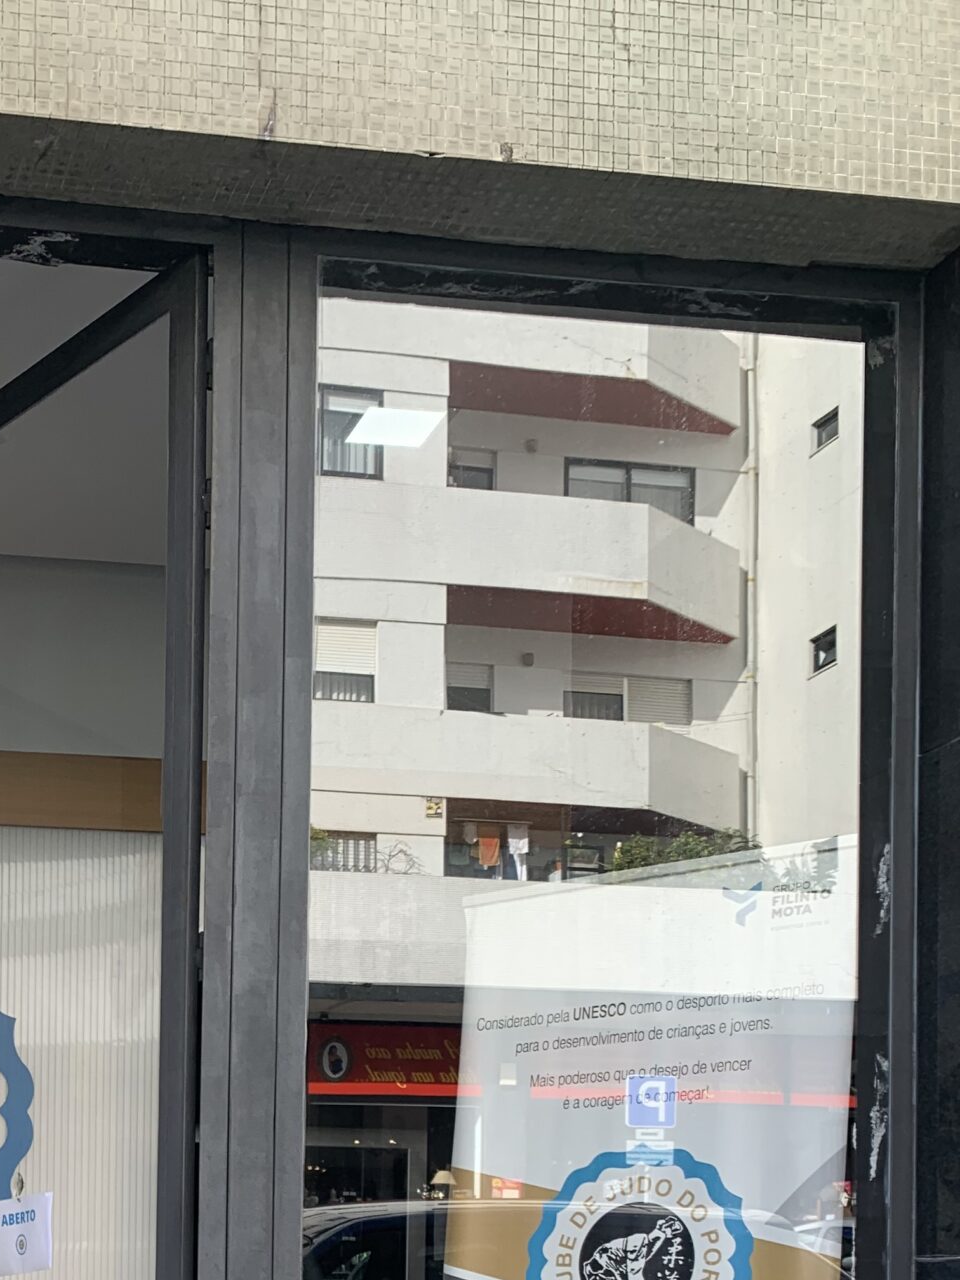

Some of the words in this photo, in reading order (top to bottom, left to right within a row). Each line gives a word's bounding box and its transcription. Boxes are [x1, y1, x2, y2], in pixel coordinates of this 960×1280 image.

[771, 889, 832, 906] FILINTO
[772, 880, 811, 892] GRUPO
[771, 904, 812, 919] MOTA
[476, 1013, 543, 1031] Considerado
[546, 1010, 569, 1027] pela
[573, 1002, 626, 1021] UNESCO
[629, 1001, 662, 1015] como
[665, 1000, 673, 1011] o
[677, 994, 729, 1011] desporto
[733, 987, 762, 1004] mais
[766, 982, 825, 1001] completo
[516, 1041, 539, 1056] para
[542, 1039, 549, 1050] o
[552, 1028, 645, 1050] desenvolvimento
[648, 1027, 663, 1041] de
[666, 1022, 716, 1039] crianças
[719, 1021, 727, 1034] e
[729, 1018, 773, 1036] jovens.
[530, 1073, 555, 1088] Mais
[558, 1070, 611, 1088] poderoso
[613, 1069, 635, 1084] que
[638, 1068, 646, 1079] o
[649, 1062, 688, 1079] desejo
[692, 1060, 707, 1074] de
[711, 1059, 753, 1073] vencer
[563, 1096, 570, 1110] é
[573, 1098, 580, 1109] a
[583, 1094, 633, 1114] coragem
[654, 1086, 709, 1104] começar!
[569, 1196, 601, 1229] DE
[606, 1176, 672, 1201] JUDO
[677, 1190, 708, 1222] DO
[1, 1209, 36, 1227] ABERTO
